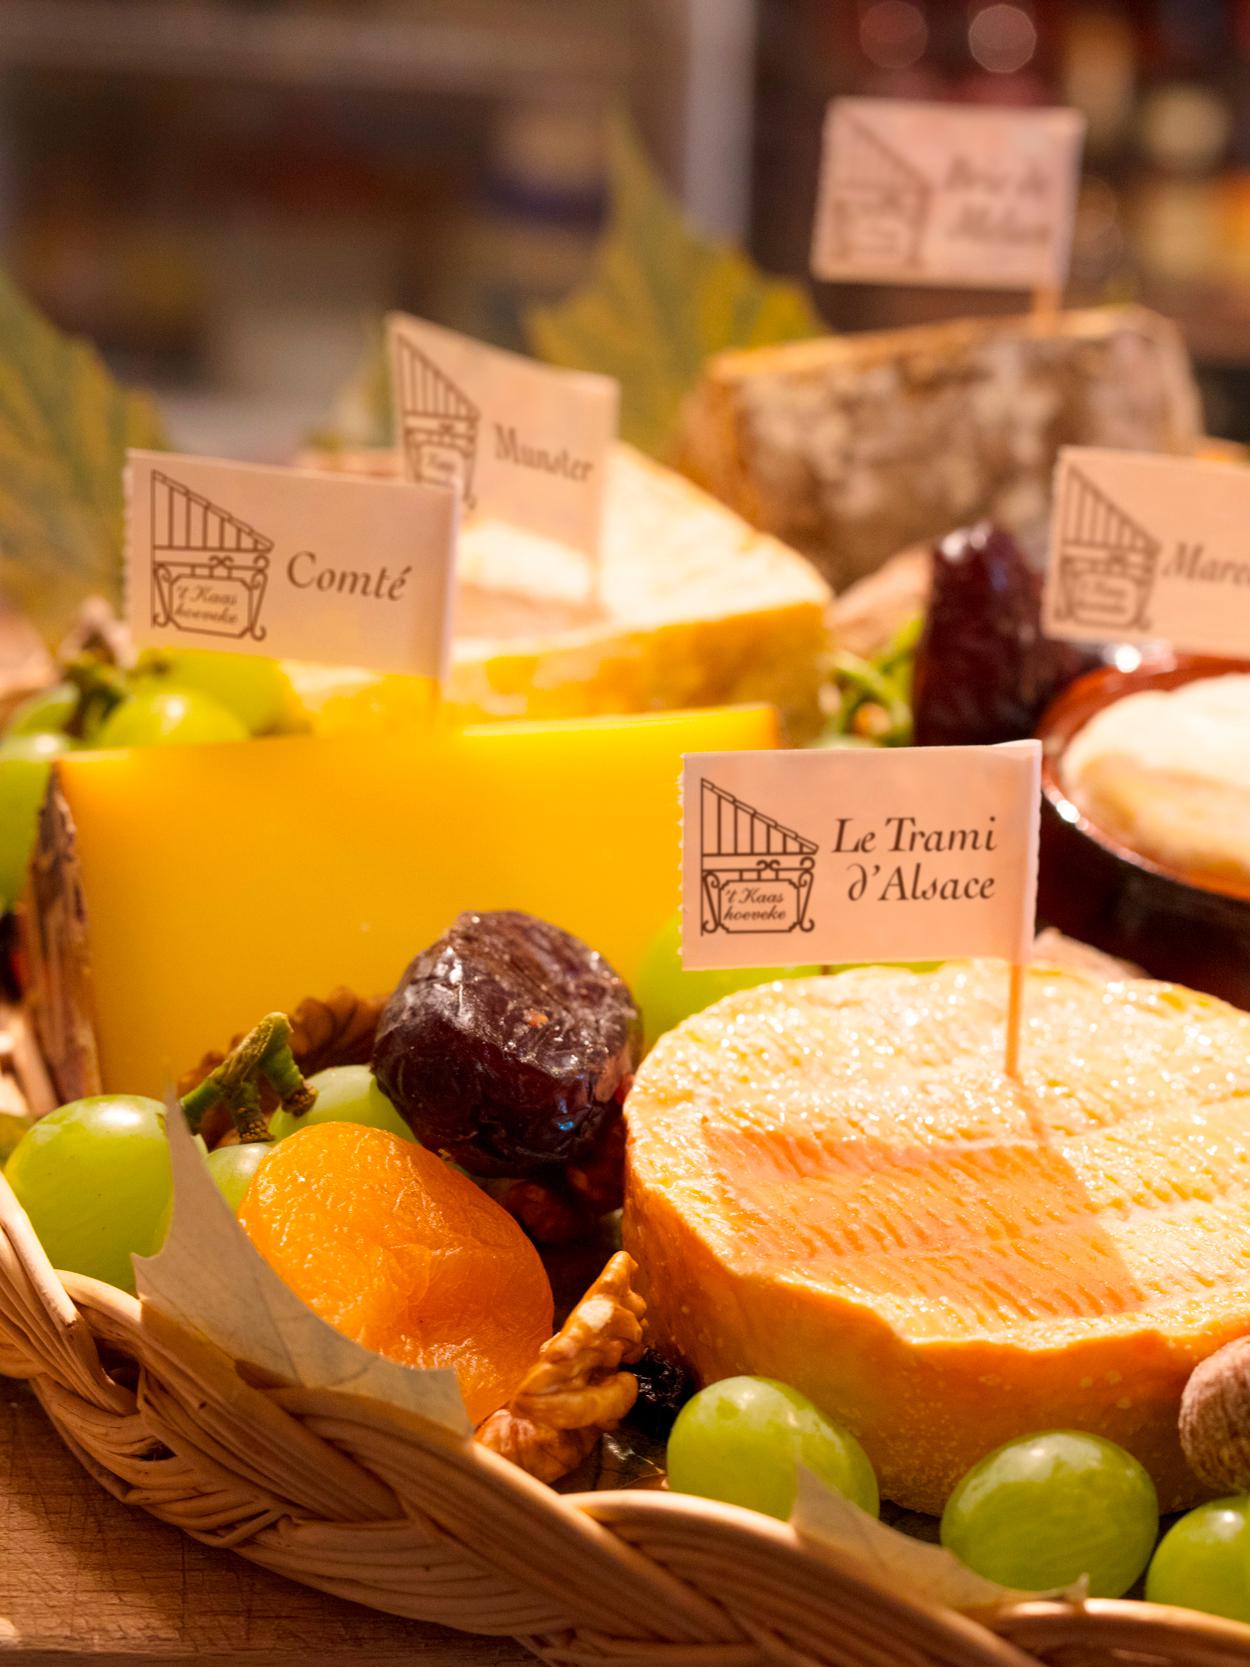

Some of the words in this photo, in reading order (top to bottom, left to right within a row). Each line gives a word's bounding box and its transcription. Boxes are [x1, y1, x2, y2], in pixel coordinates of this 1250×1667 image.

[493, 421, 594, 482] Munster
[286, 550, 413, 602] Comté
[833, 817, 877, 854] Le
[885, 816, 998, 853] Trami
[738, 887, 785, 905] Kaas
[847, 862, 997, 902] d'Alsace
[723, 905, 787, 921] hoeveke
